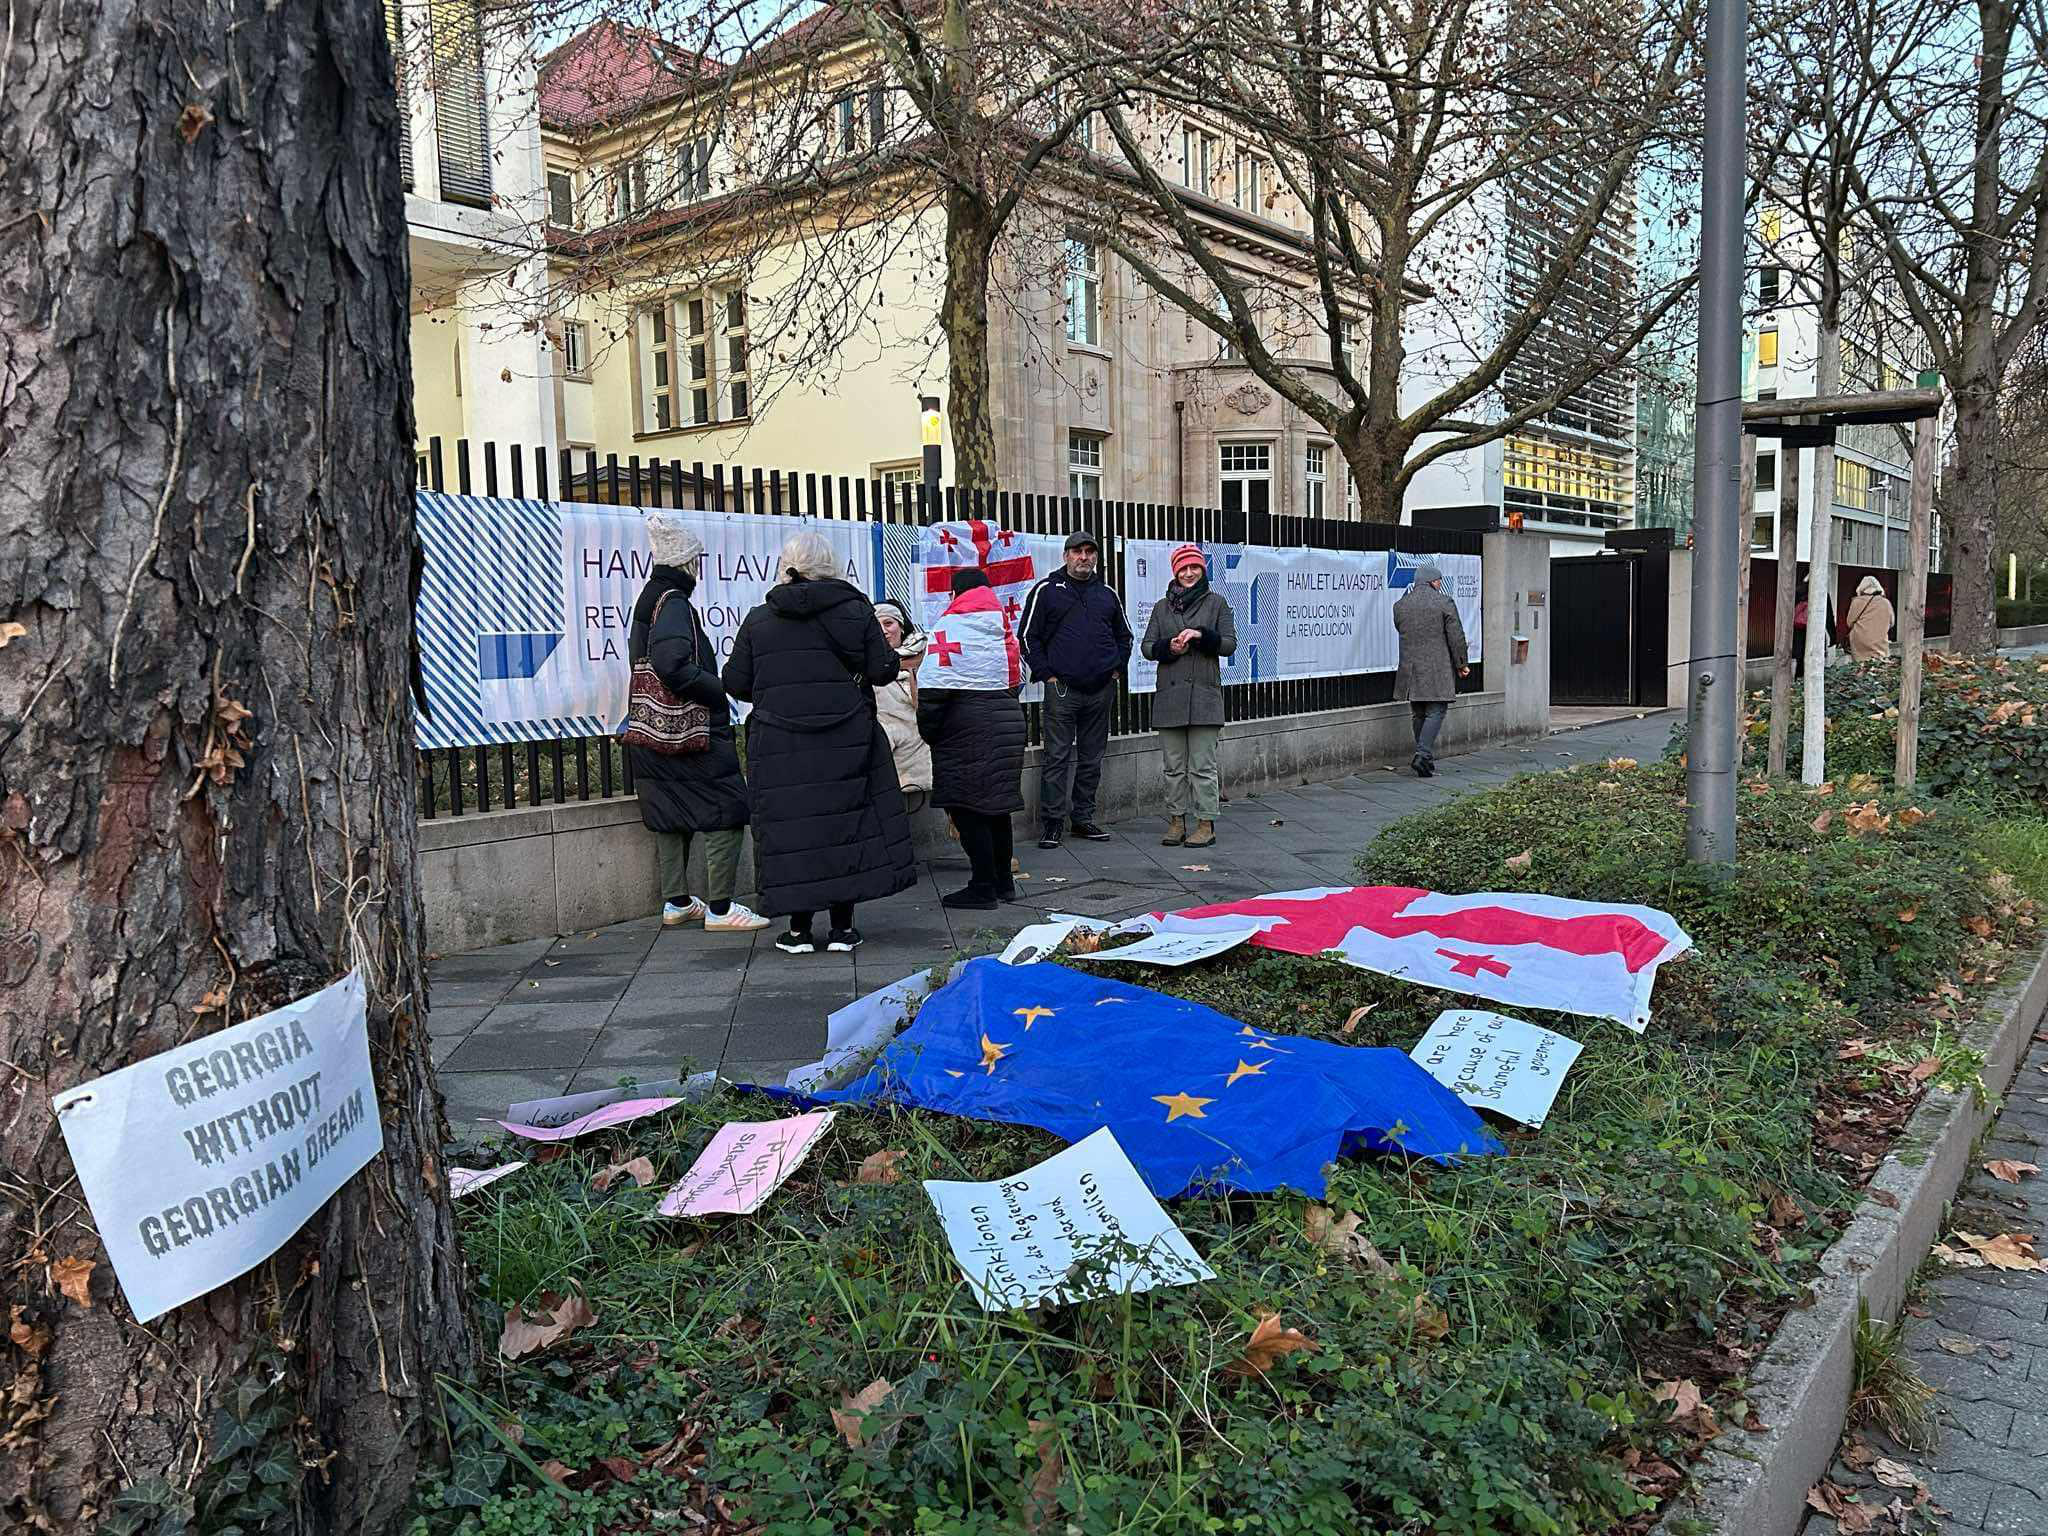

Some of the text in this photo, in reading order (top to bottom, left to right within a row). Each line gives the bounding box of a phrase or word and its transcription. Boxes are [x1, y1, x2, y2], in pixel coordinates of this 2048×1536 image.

[584, 548, 710, 582] HAMT
[1287, 573, 1384, 591] HAMLET LAVASTIDA
[584, 602, 741, 630] REVIÓN
[1286, 602, 1355, 619] REVOLUCIÓN SIN
[1286, 621, 1352, 638] LA REVOLUCIÓN
[586, 638, 620, 662] LA
[1426, 1015, 1473, 1065] are here
[1473, 1030, 1496, 1044] of
[164, 1019, 313, 1109] GEORGIA
[183, 1071, 321, 1169] WITHOUT
[138, 1087, 365, 1260] GEORGIAN DREAM
